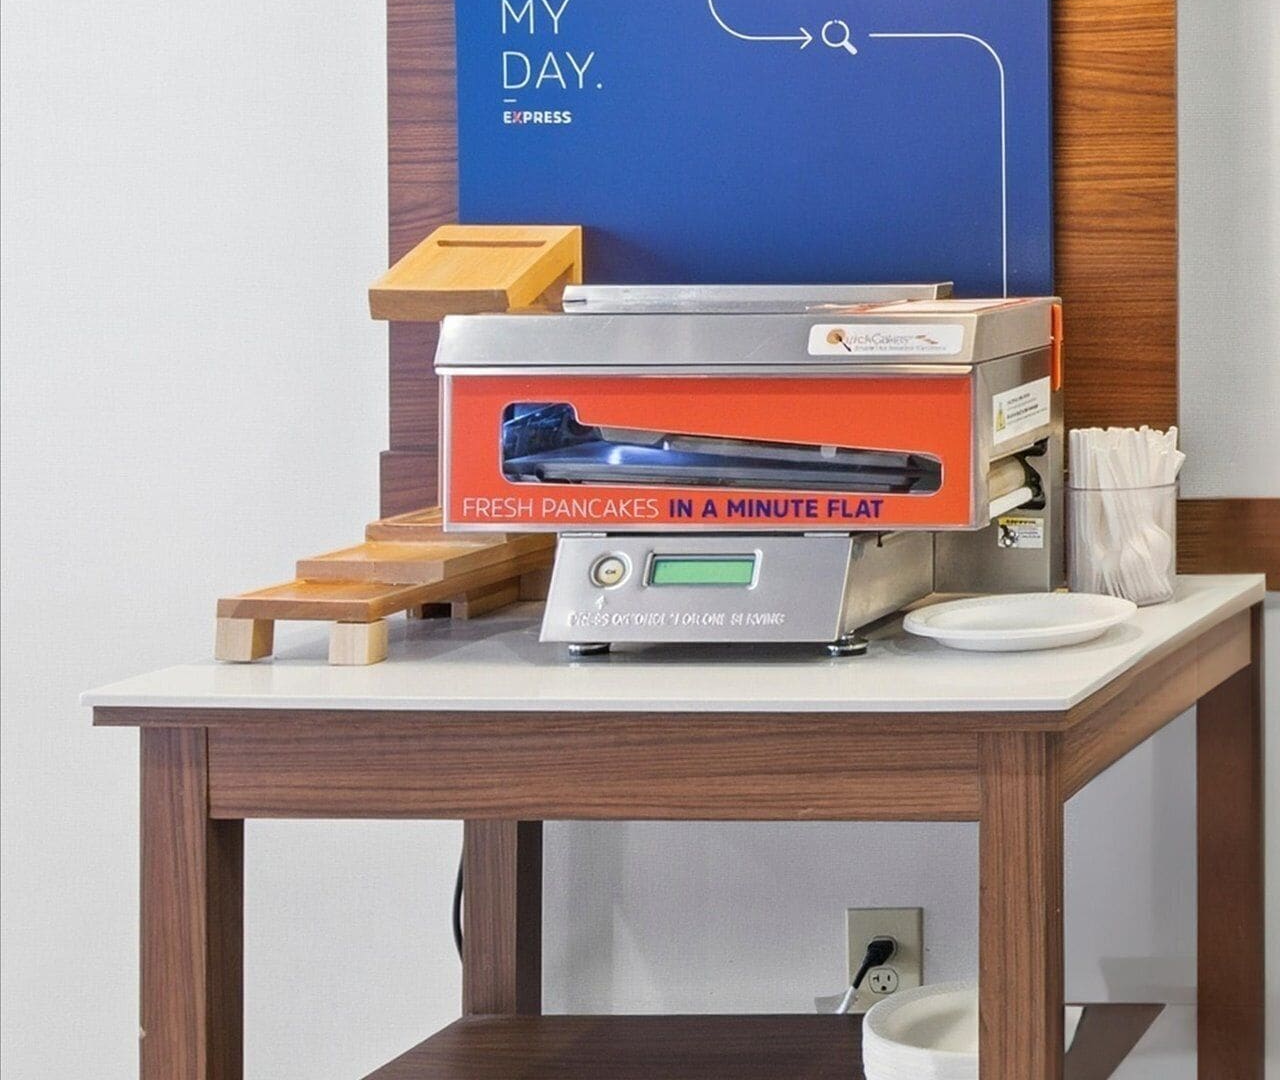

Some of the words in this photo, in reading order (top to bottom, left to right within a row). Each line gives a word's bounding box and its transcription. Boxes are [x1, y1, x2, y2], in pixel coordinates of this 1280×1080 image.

[502, 52, 602, 90] DAY.
[504, 111, 572, 124] EXPRESS
[463, 497, 534, 518] FRESH
[541, 497, 660, 519] PANCAKES
[669, 499, 693, 519] IN
[701, 499, 718, 519] A
[726, 499, 819, 519] MINUTE
[827, 498, 885, 519] FLAT
